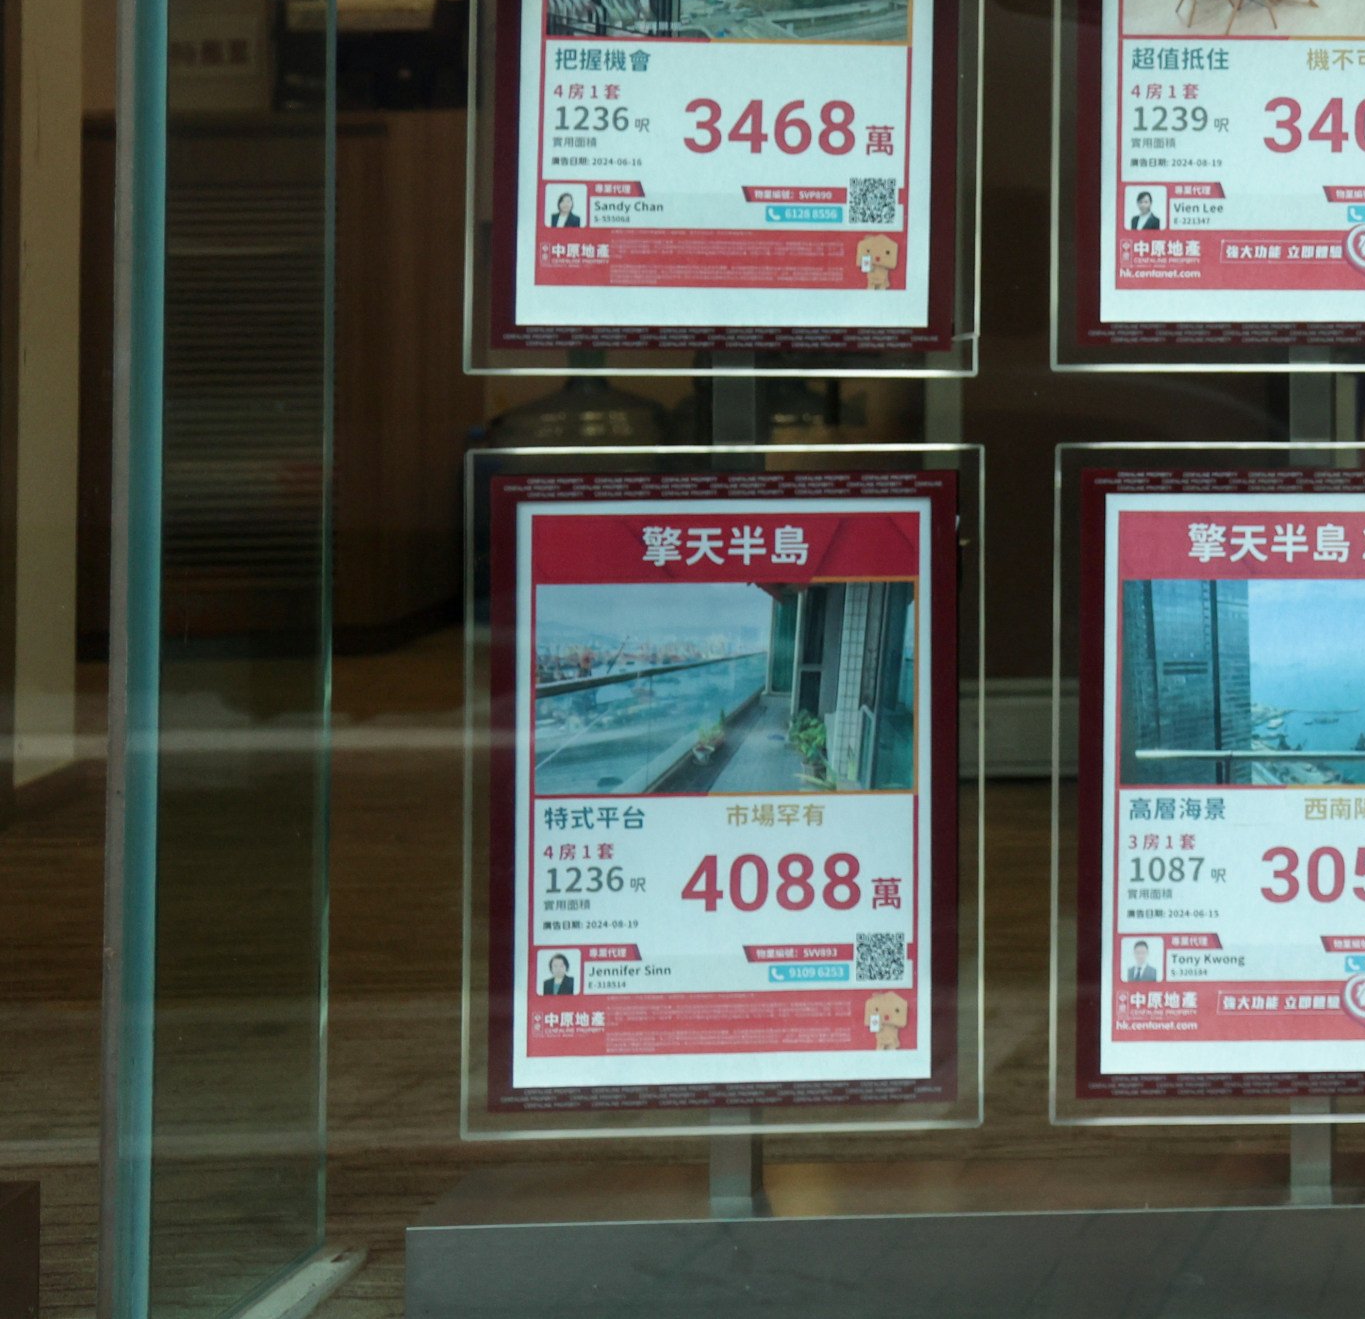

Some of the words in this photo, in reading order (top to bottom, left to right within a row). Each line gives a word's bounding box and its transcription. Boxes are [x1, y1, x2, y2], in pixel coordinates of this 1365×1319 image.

[555, 48, 651, 72] 把握機會
[1132, 48, 1230, 70] 超值抵住
[1131, 137, 1176, 149] 實用面積
[1171, 158, 1222, 167] 2024-08-19
[594, 200, 631, 214] Sandy
[634, 201, 663, 212] Chan
[1174, 203, 1199, 213] Vien
[1203, 203, 1224, 213] Lee
[552, 244, 609, 258] 中原地產
[1134, 240, 1200, 256] 中原地產
[1120, 269, 1200, 278] hk.centanet.com
[643, 525, 808, 565] 擎天半島
[1189, 524, 1350, 562] 擎天半島
[1130, 798, 1226, 821] 高層海景
[545, 806, 645, 830] 特式平台
[727, 805, 825, 826] 市場罕有
[1128, 889, 1172, 899] 實用面積
[544, 900, 590, 910] 實用面積
[586, 920, 638, 929] 2024-08-19
[1171, 955, 1200, 967] Tony
[1204, 955, 1245, 967] Kwong
[589, 965, 640, 977] Jennifer
[644, 965, 671, 976] Sinn
[1130, 992, 1197, 1008] 中原地產
[545, 1013, 605, 1026] 中原地產
[1116, 1021, 1197, 1031] hk.centanet.com
